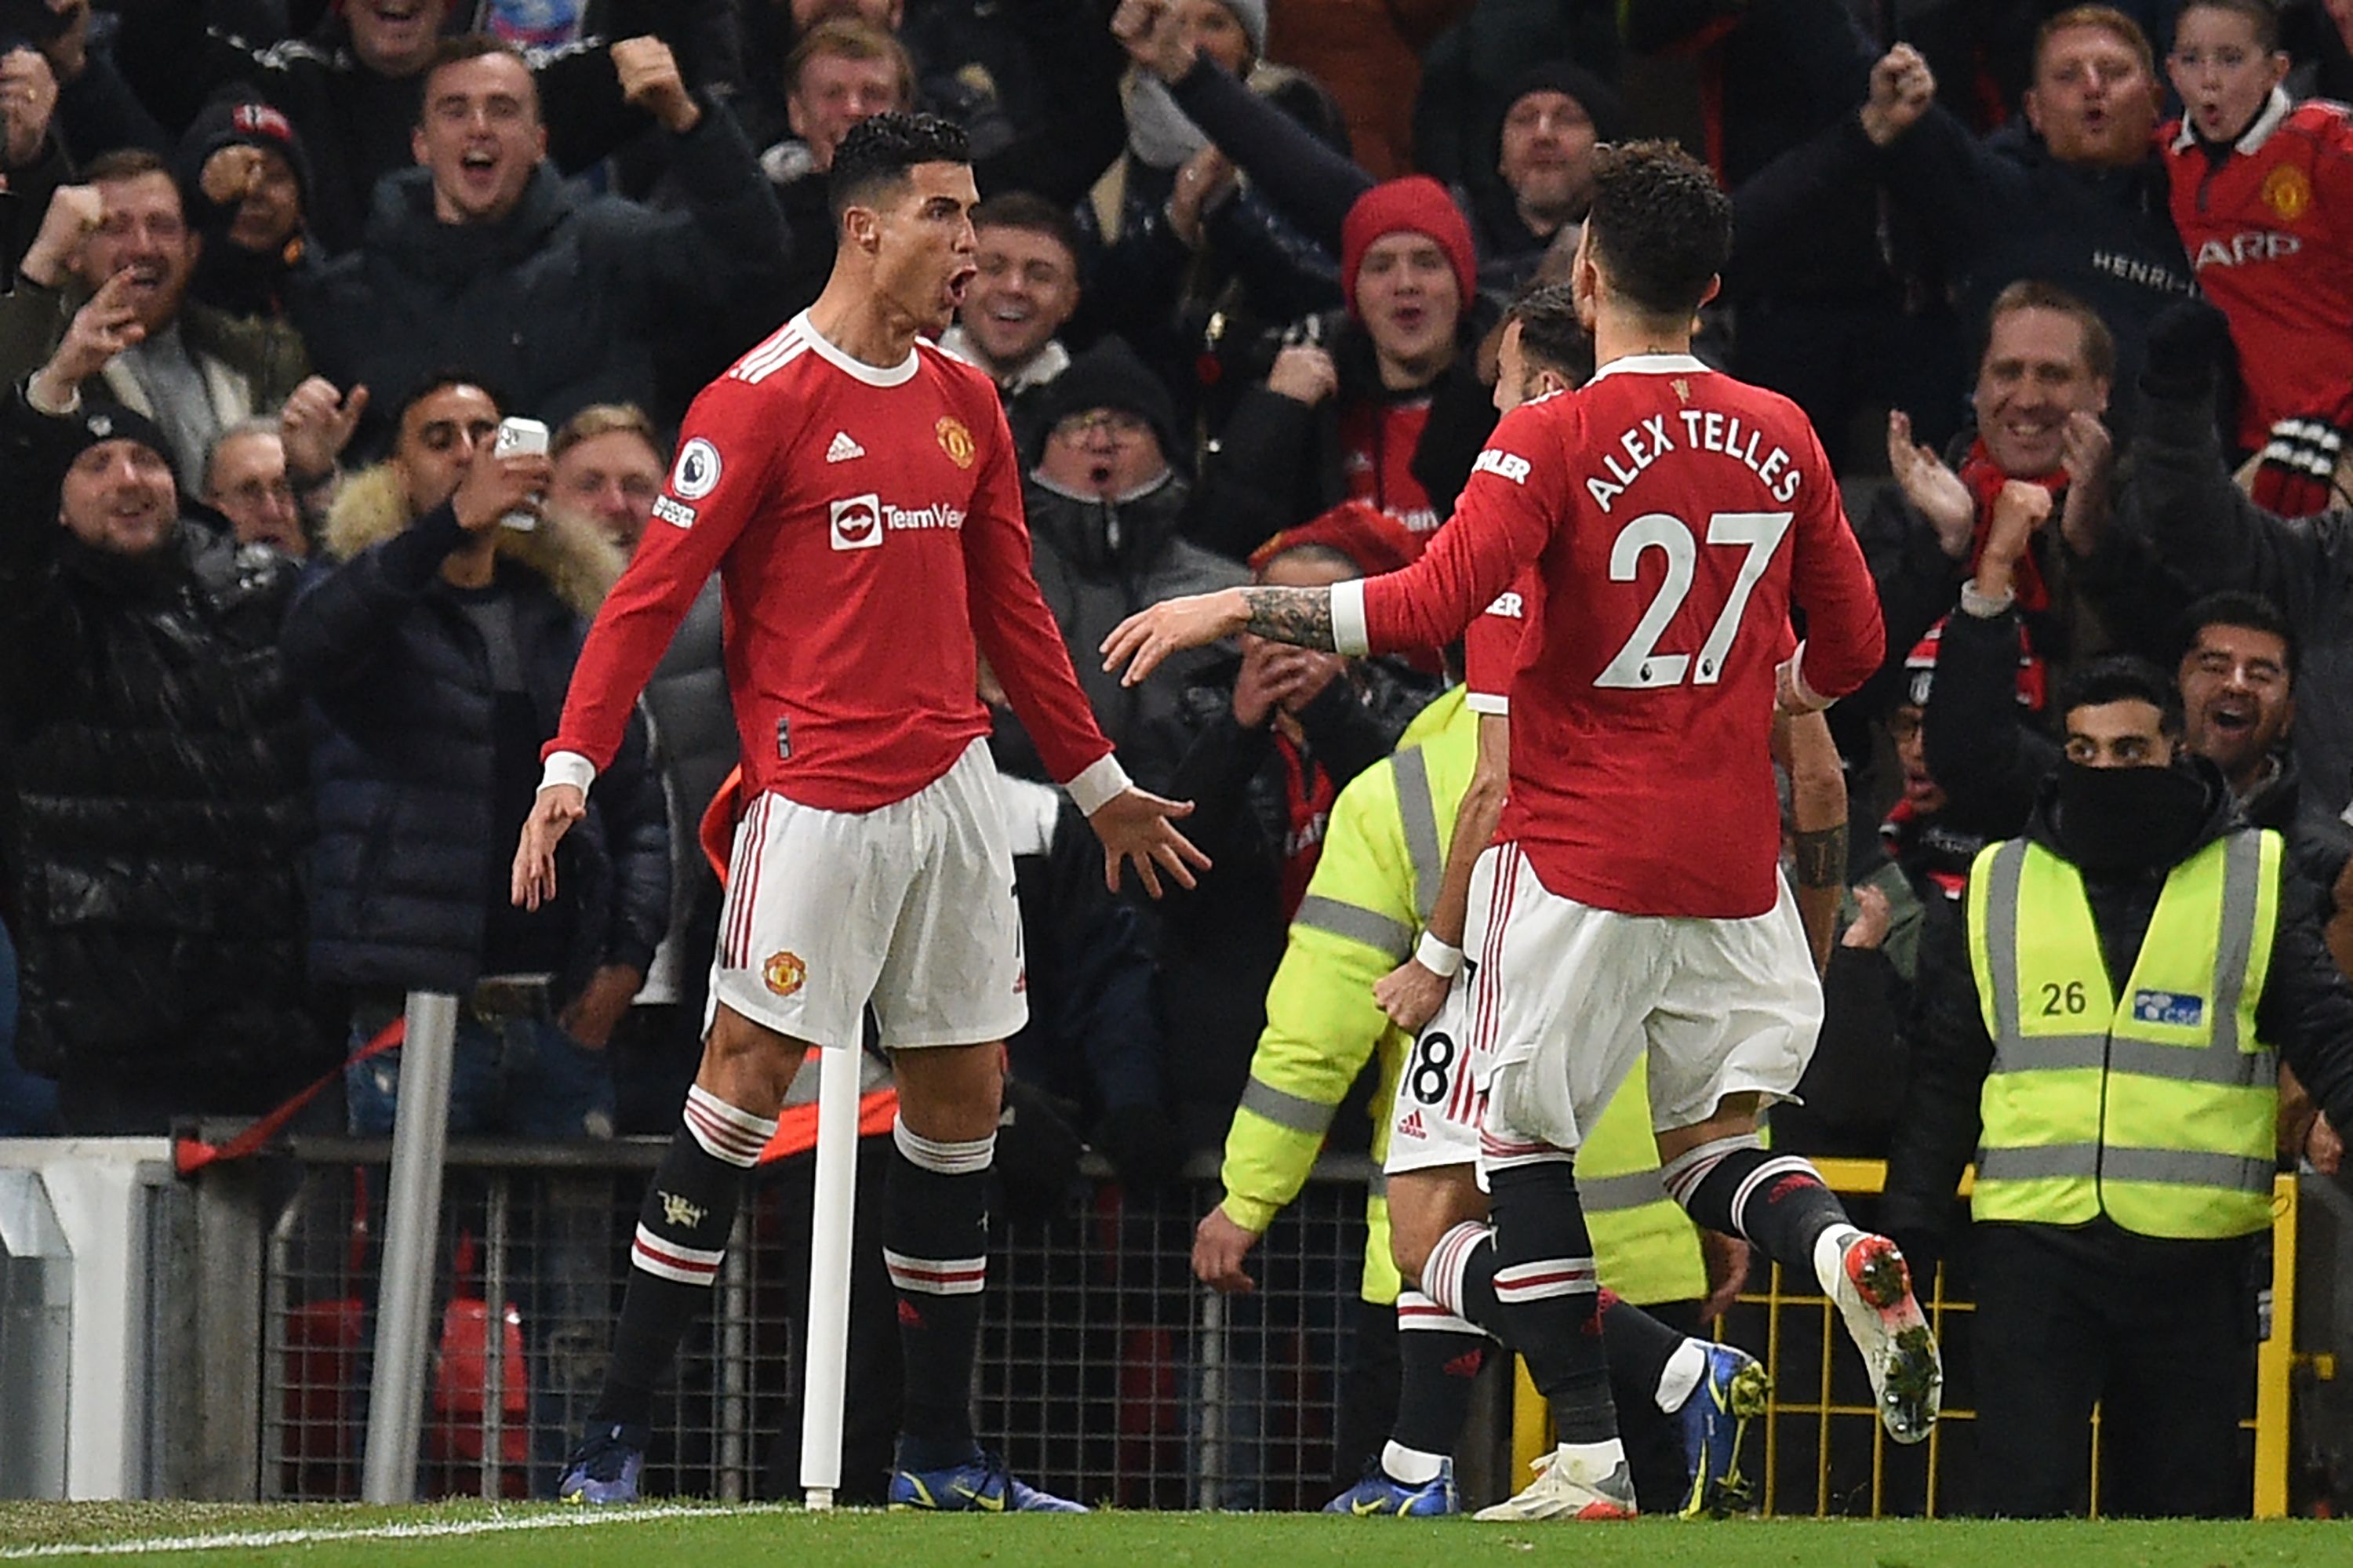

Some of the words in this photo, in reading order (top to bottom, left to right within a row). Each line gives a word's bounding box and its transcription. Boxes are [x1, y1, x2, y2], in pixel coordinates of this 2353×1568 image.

[1586, 413, 1675, 513] ALEX
[1679, 409, 1801, 503] TELLES
[1592, 511, 1795, 689] 27
[2042, 981, 2086, 1017] 26
